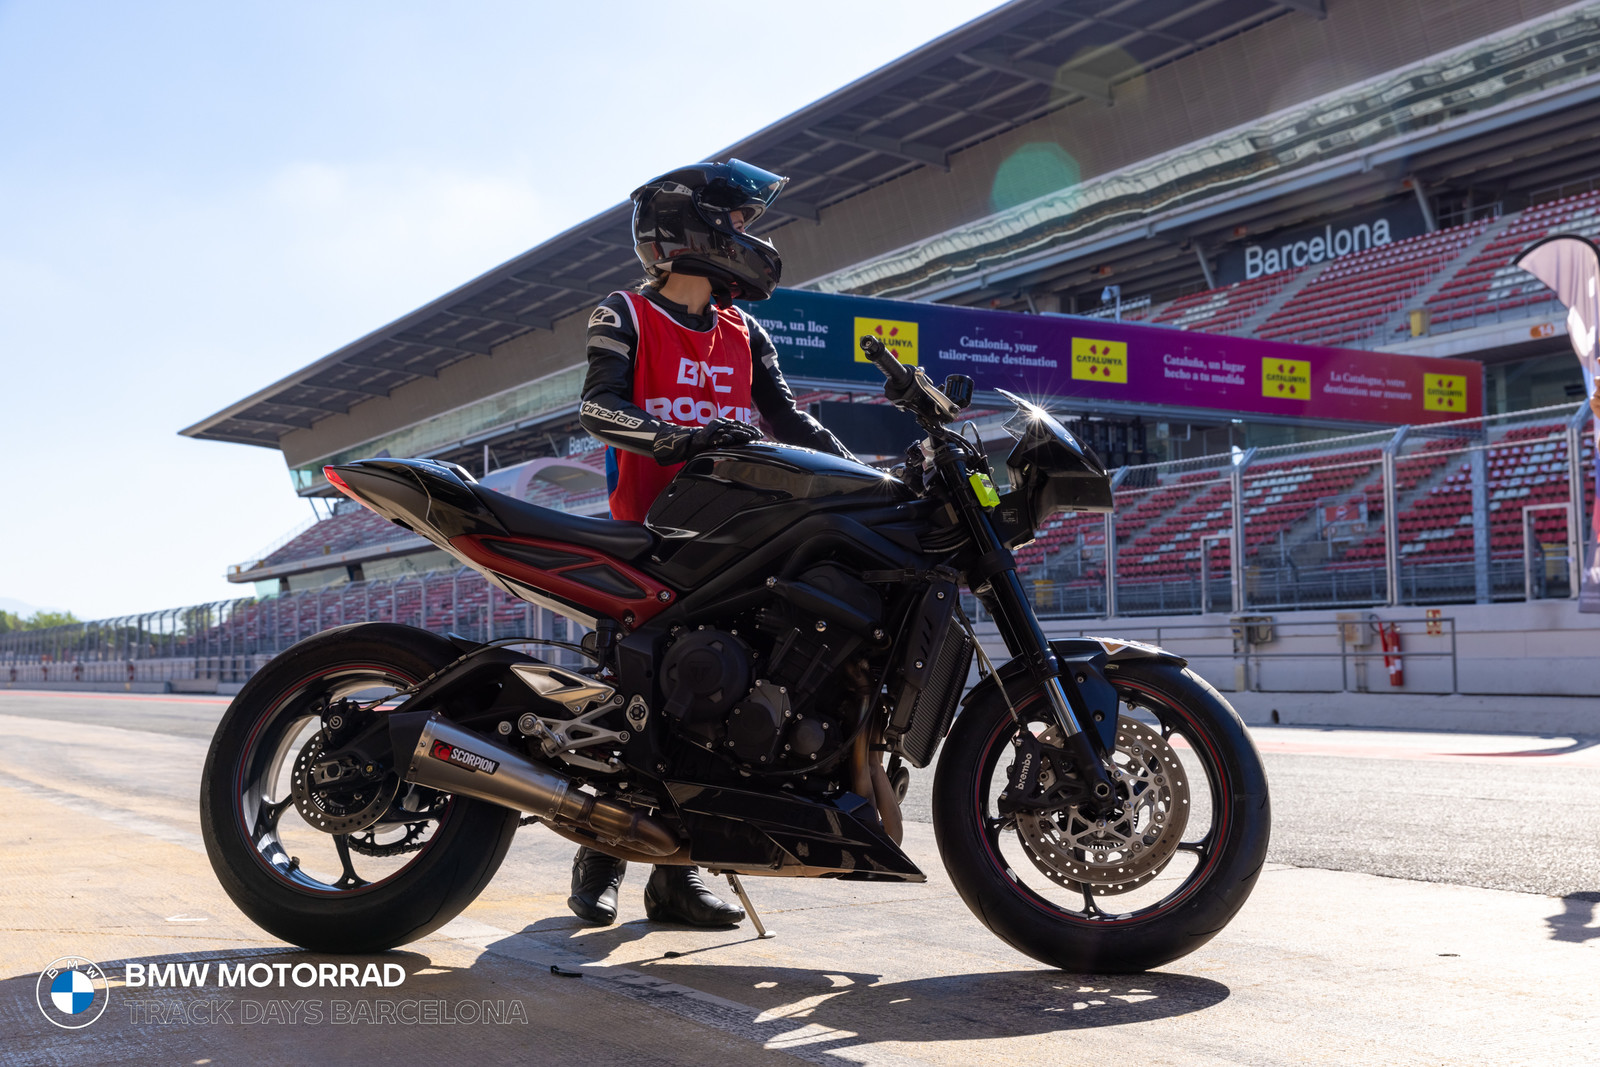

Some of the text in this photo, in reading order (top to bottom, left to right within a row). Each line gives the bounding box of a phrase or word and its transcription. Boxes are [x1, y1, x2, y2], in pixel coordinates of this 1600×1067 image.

[1245, 218, 1392, 280] Barcelona
[789, 321, 806, 331] un
[807, 320, 829, 334] lloc
[795, 335, 826, 348] mida
[877, 337, 913, 348] ALUNYA
[960, 336, 1038, 354] Catalonia, your
[938, 349, 1058, 368] tailor-made destination
[1076, 354, 1123, 366] CATALUNYA
[1208, 361, 1221, 370] un
[1222, 360, 1246, 374] lugar
[1164, 367, 1245, 385] hecho a tu medida
[1265, 373, 1307, 384] CATALUNYA
[1330, 371, 1342, 382] La
[1323, 383, 1368, 396] destination
[581, 401, 643, 428] pinestars
[450, 748, 496, 773] SCORPION
[1015, 753, 1032, 790] brembo
